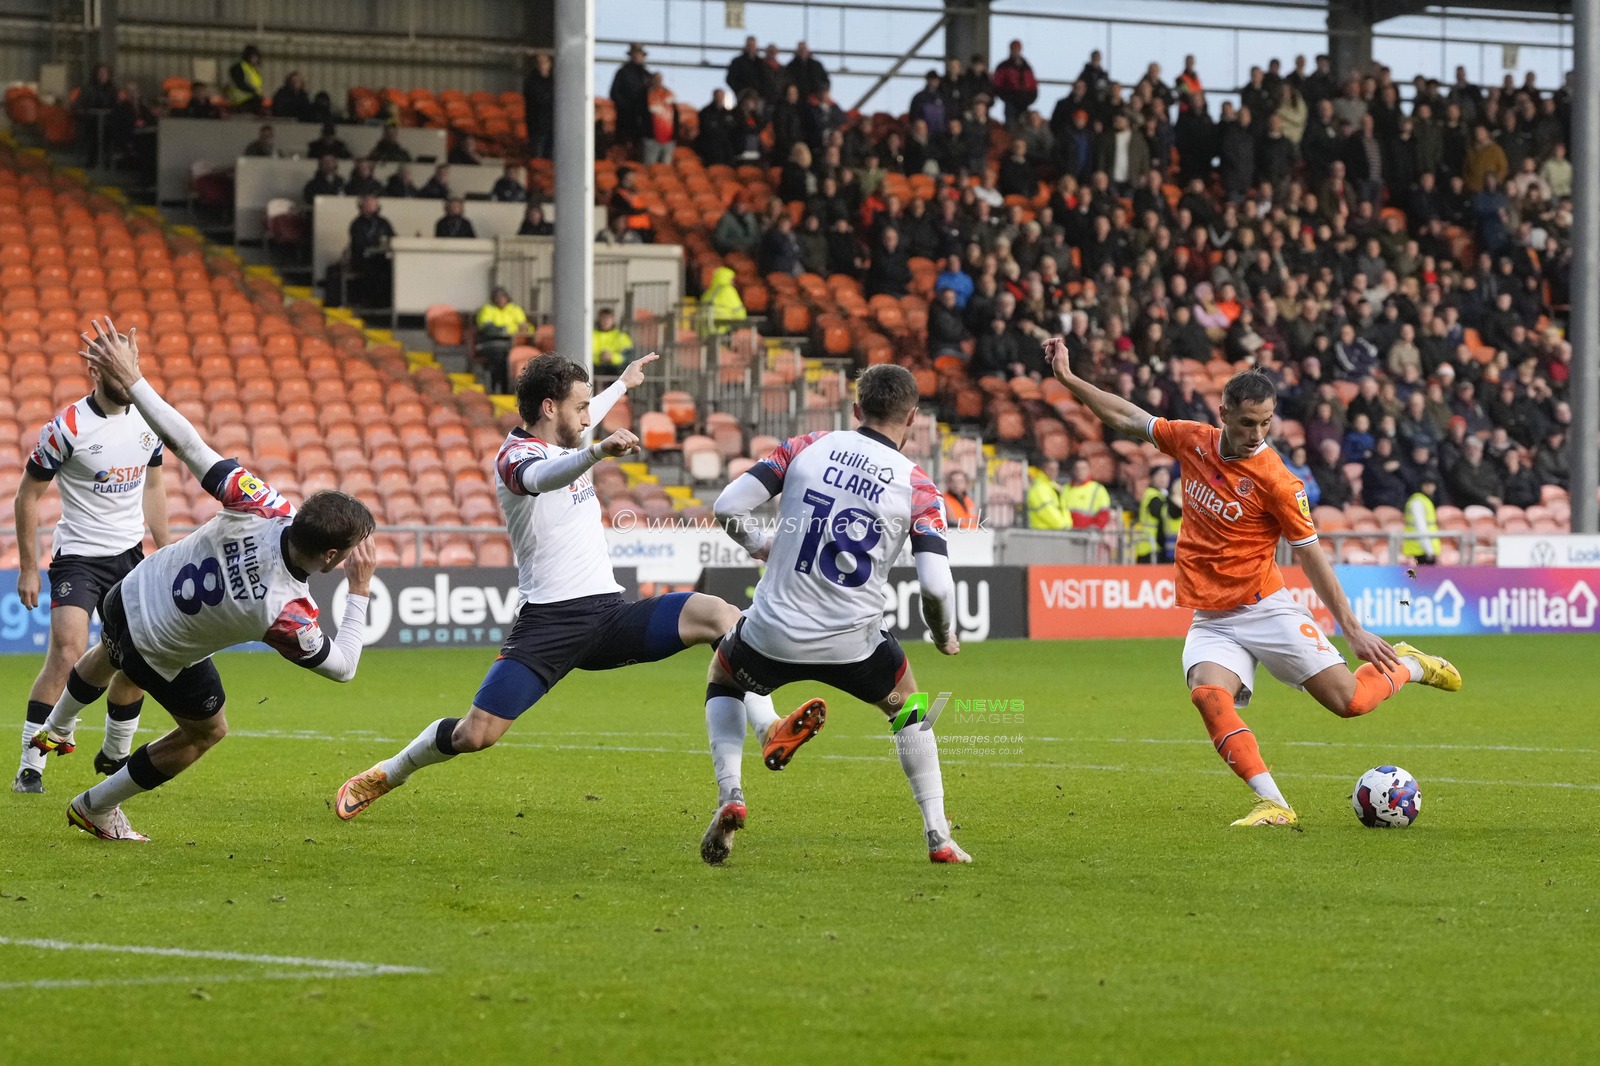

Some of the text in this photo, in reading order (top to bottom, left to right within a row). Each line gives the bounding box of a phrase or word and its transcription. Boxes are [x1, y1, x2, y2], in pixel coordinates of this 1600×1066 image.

[829, 450, 878, 477] utilita
[822, 466, 885, 504] CLARK
[1185, 479, 1223, 514] utilita
[608, 540, 675, 558] ookers
[699, 542, 749, 564] Blac
[794, 488, 881, 588] 18
[222, 541, 249, 601] BERRY
[241, 535, 261, 585] utilita
[172, 556, 226, 616] 8
[1478, 587, 1569, 628] utilita
[399, 628, 503, 643] SPORTS
[1299, 623, 1321, 645] 9
